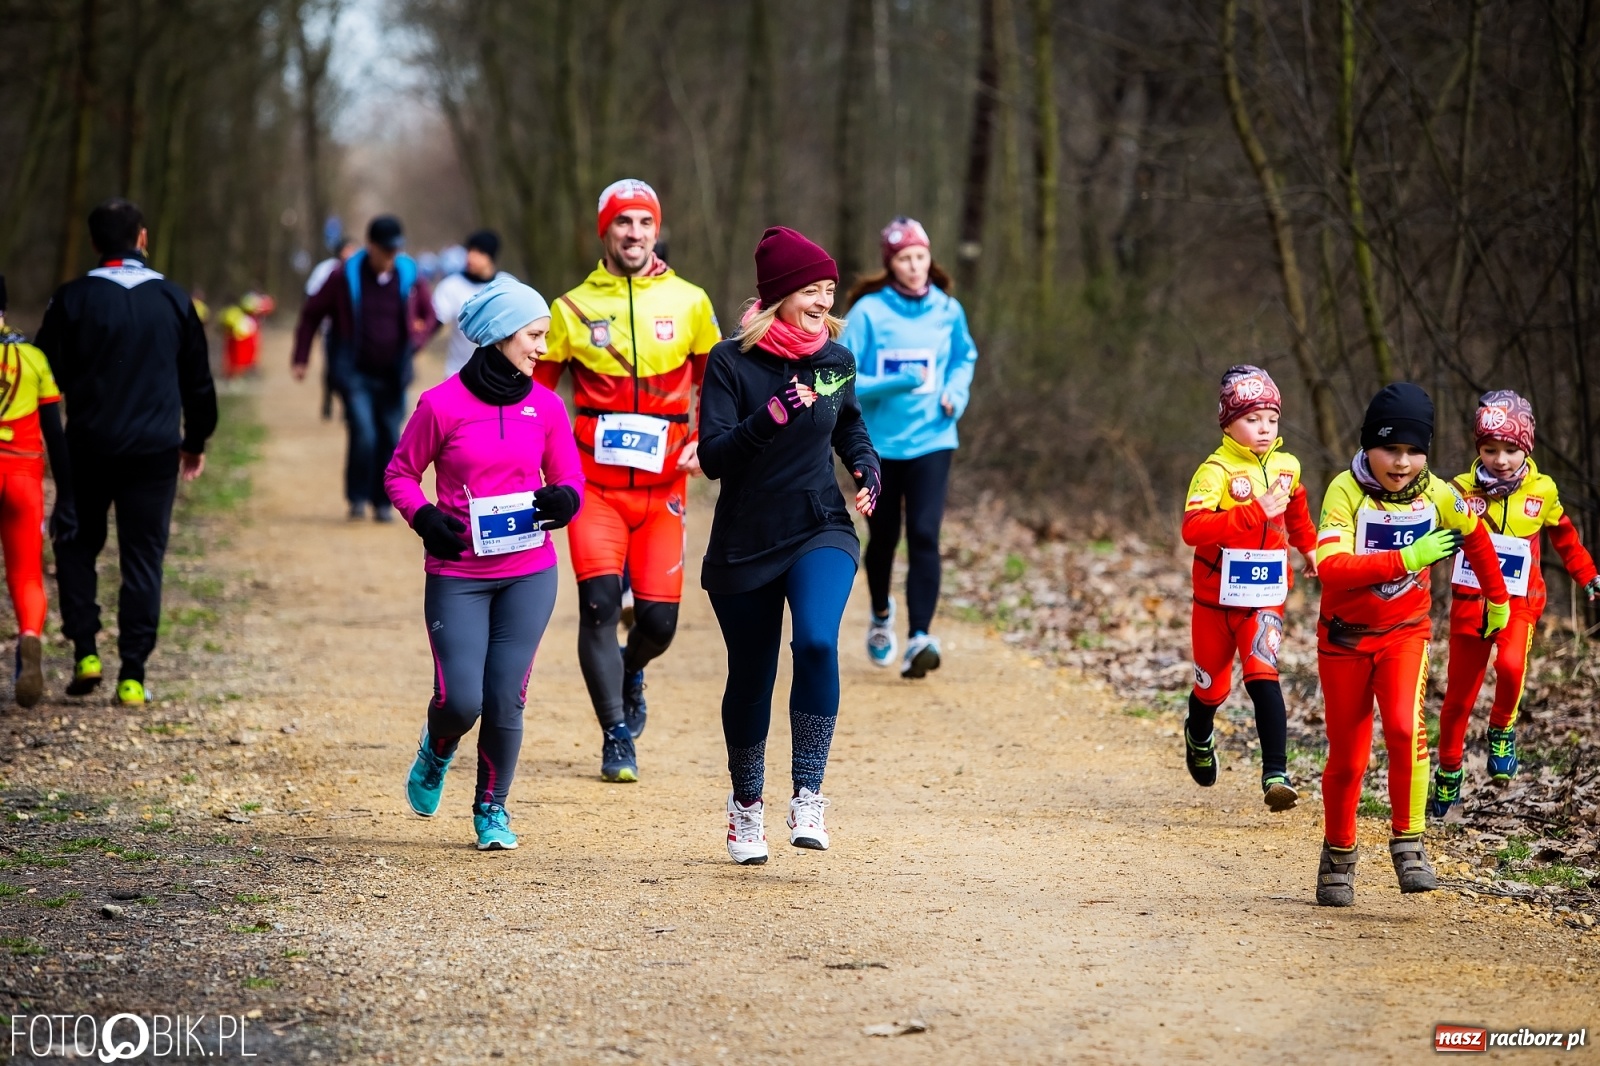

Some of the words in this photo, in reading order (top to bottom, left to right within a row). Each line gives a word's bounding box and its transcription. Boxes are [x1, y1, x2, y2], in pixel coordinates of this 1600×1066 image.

[1378, 427, 1393, 437] 4F
[622, 433, 640, 447] 97
[507, 517, 516, 531] 3
[1393, 530, 1414, 545] 16
[1251, 566, 1269, 581] 98
